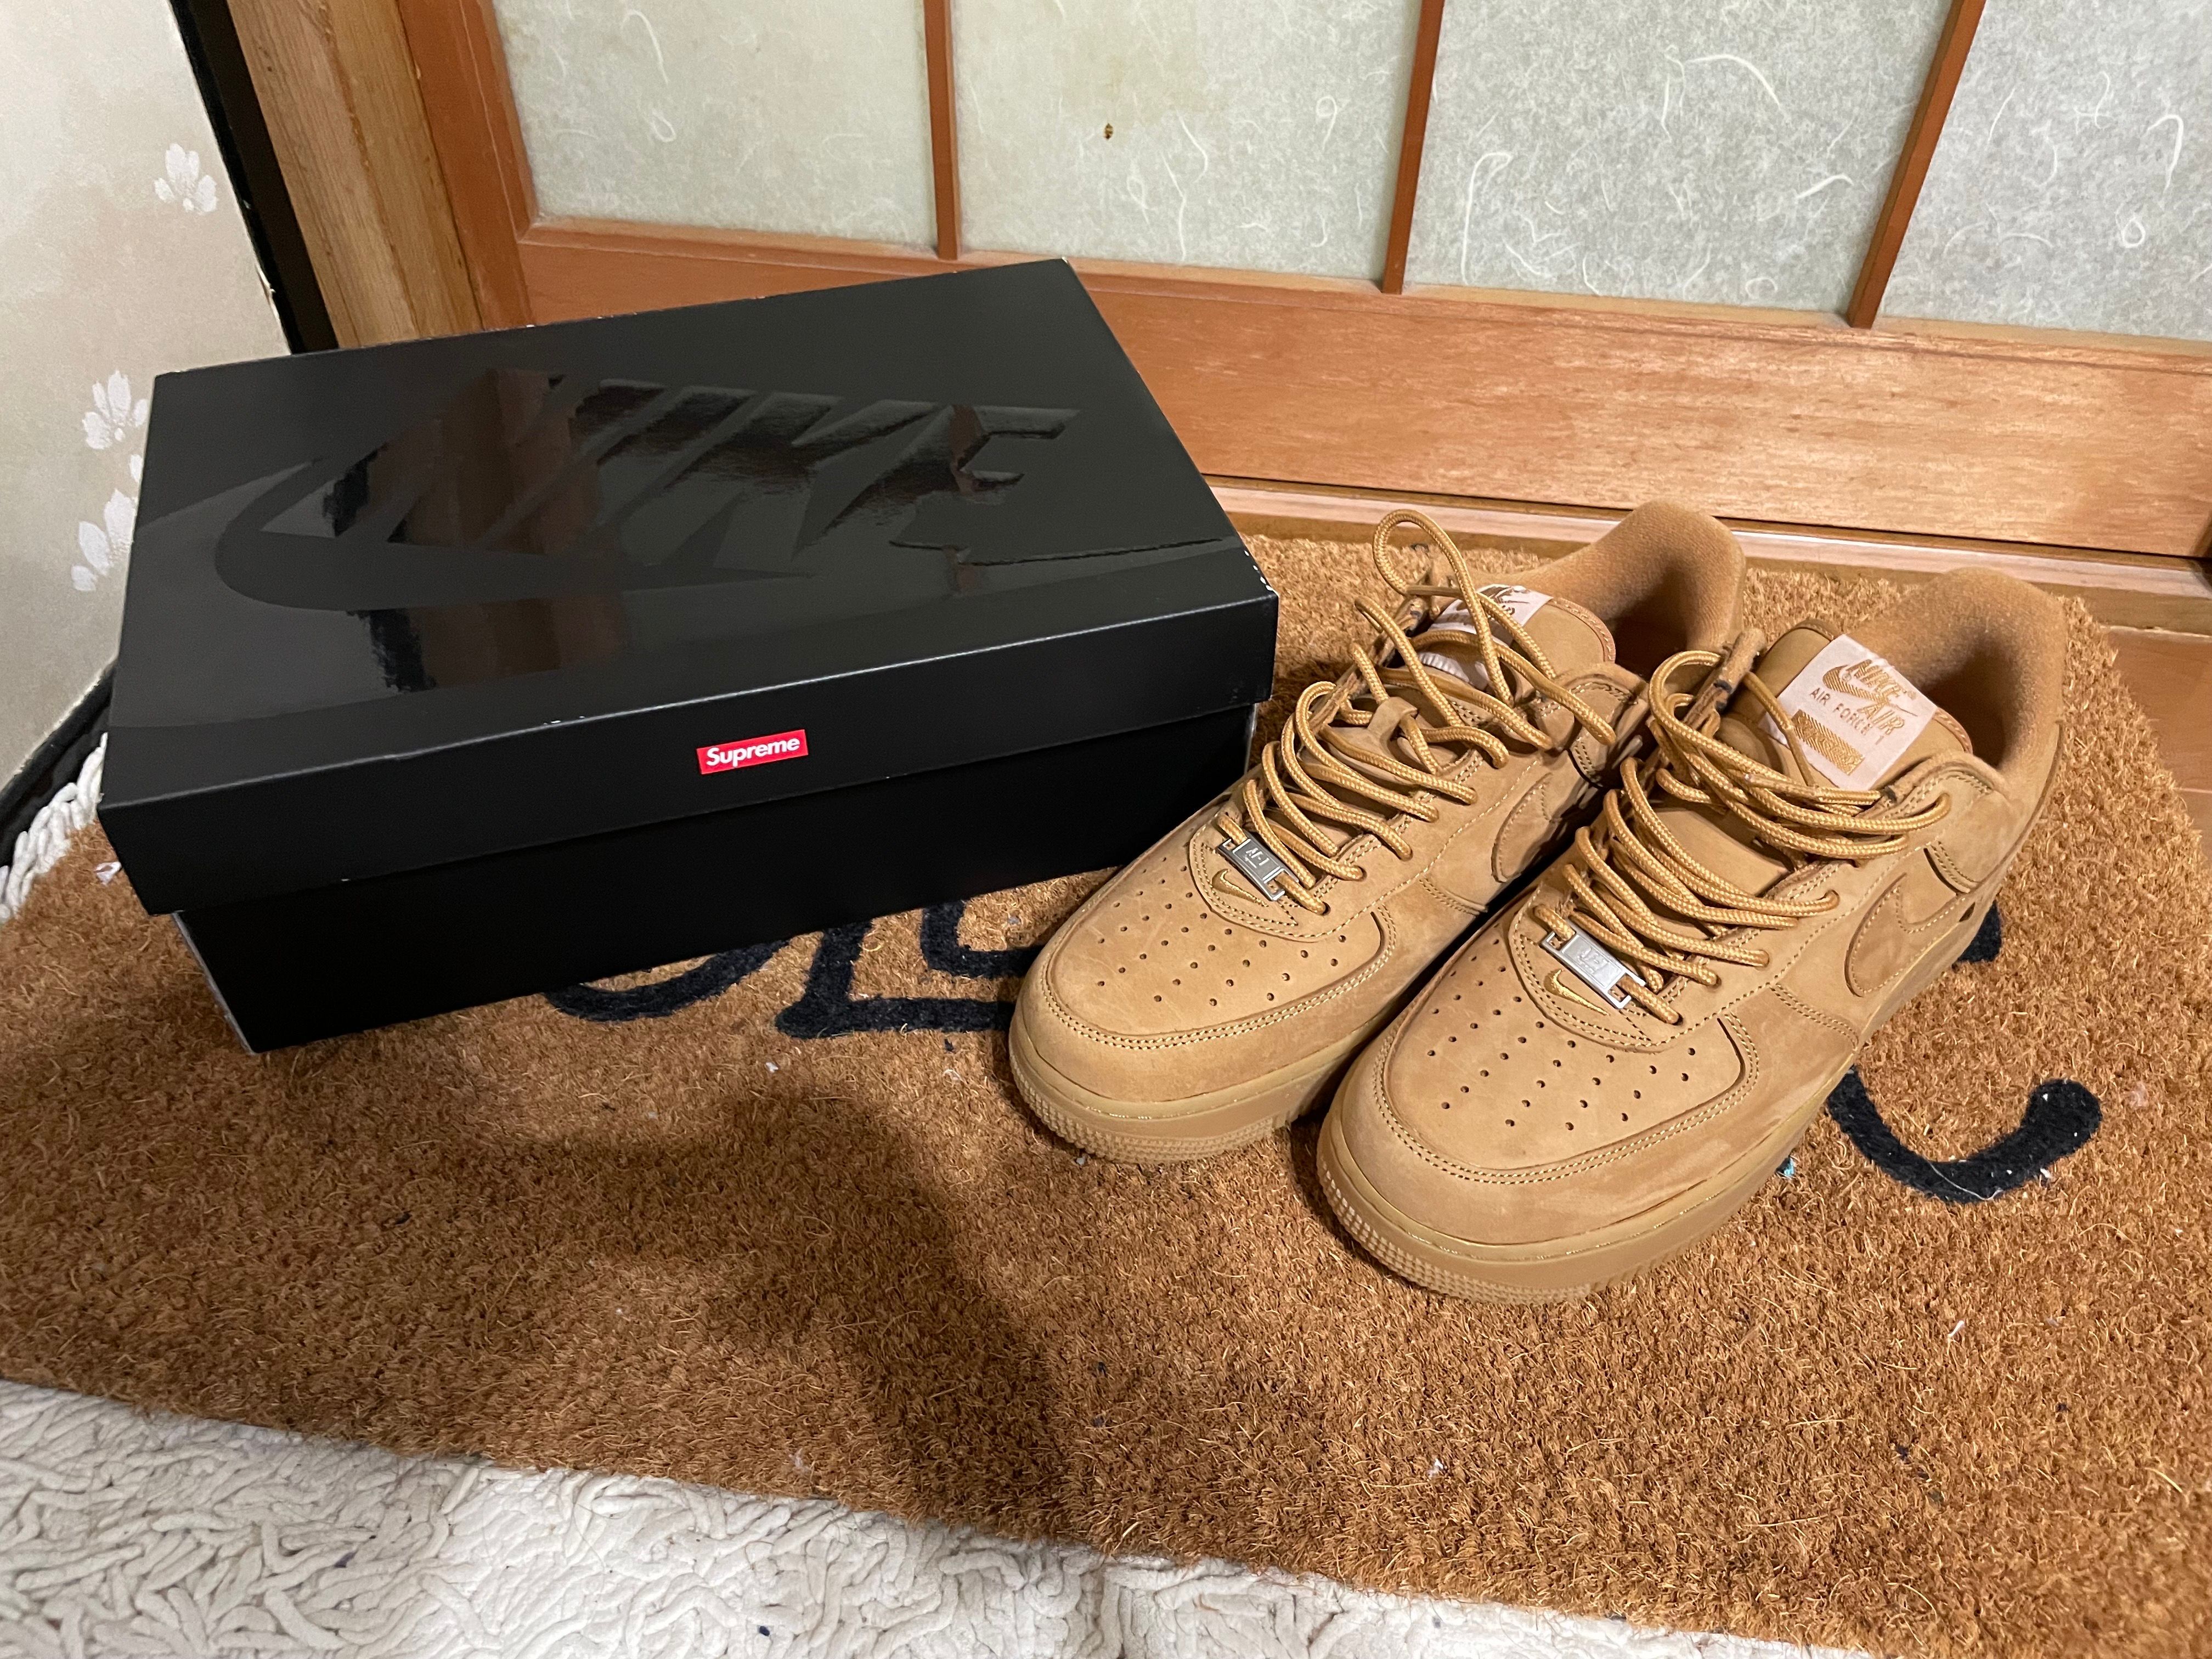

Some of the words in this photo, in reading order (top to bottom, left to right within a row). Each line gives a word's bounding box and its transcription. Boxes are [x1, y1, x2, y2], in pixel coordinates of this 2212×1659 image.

[1845, 658, 1908, 699] NIKE
[1810, 687, 1831, 706] AIR
[1832, 703, 1873, 735] FORCE
[1857, 700, 1905, 735] AIR
[706, 738, 800, 768] Supreme
